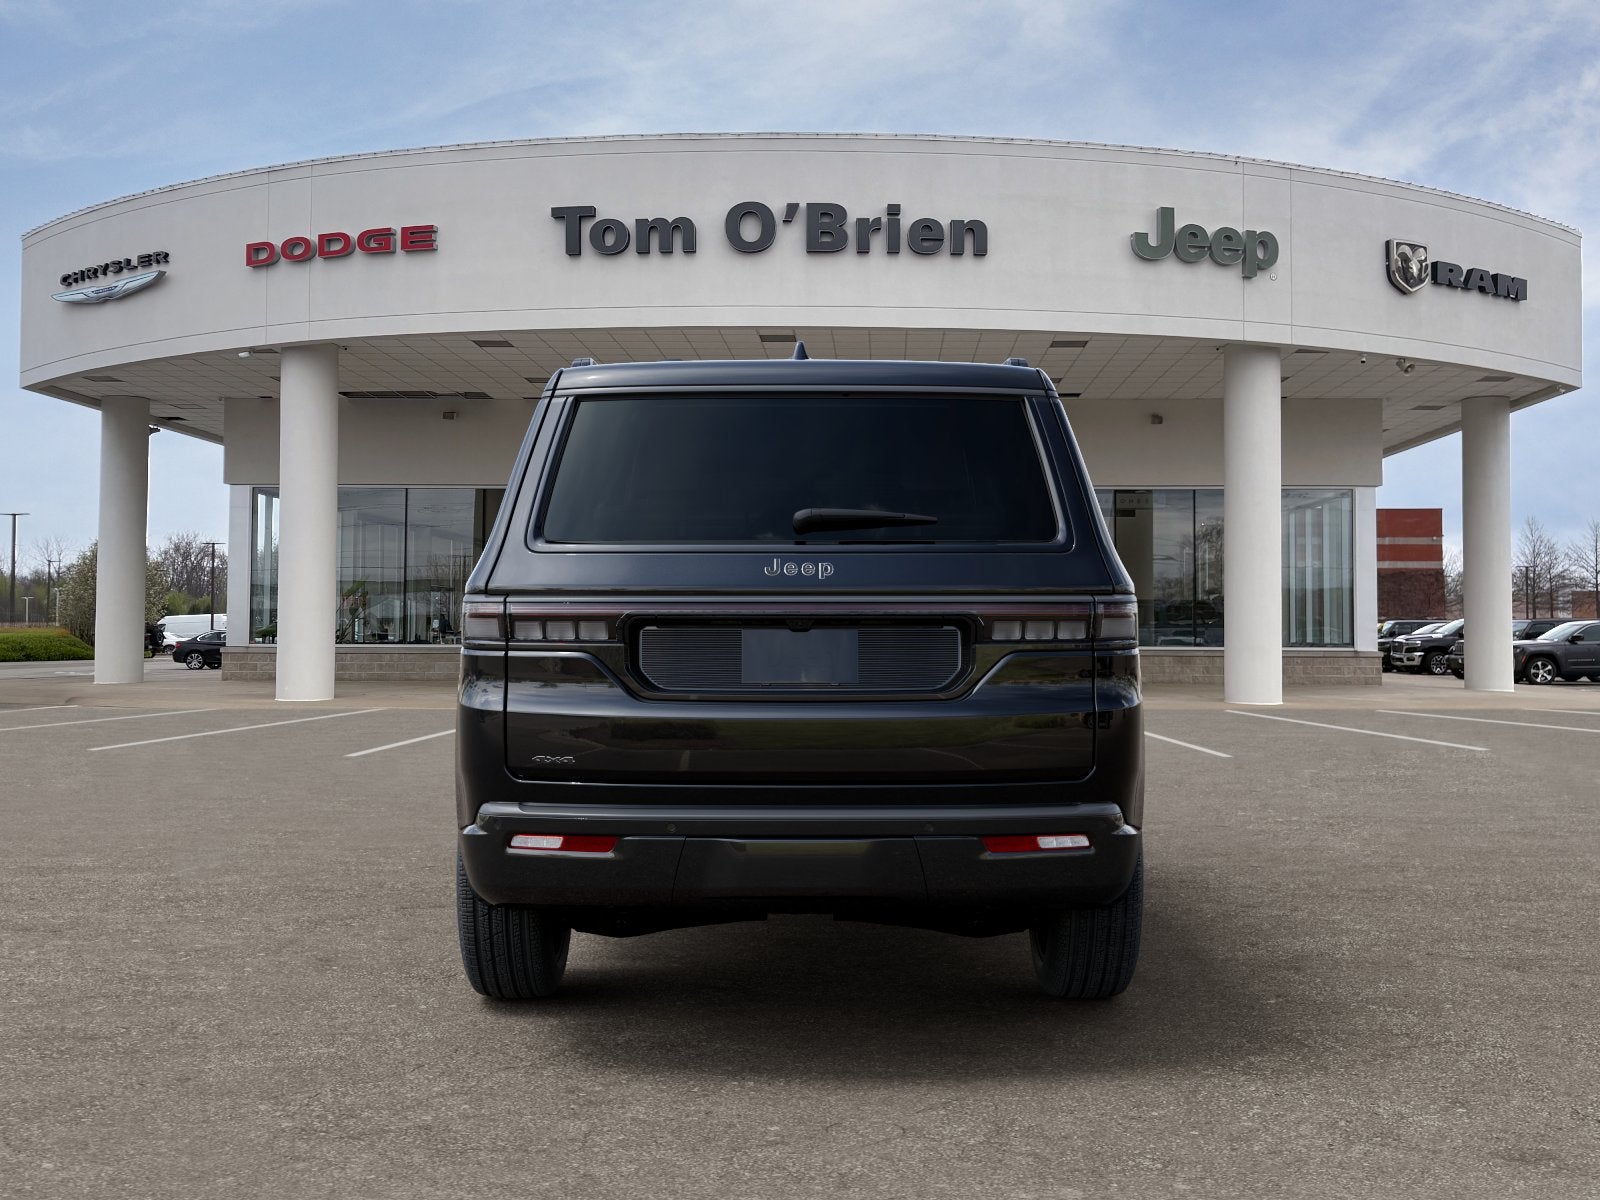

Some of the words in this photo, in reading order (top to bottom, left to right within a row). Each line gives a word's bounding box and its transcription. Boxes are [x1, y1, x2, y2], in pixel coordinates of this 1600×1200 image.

[246, 224, 438, 268] DODGE
[551, 206, 696, 256] Tom
[725, 201, 988, 256] O'Brien
[1131, 206, 1279, 278] Jeep
[60, 250, 170, 287] CHRYSLER
[1431, 260, 1528, 301] RAM
[764, 558, 834, 580] Jeep
